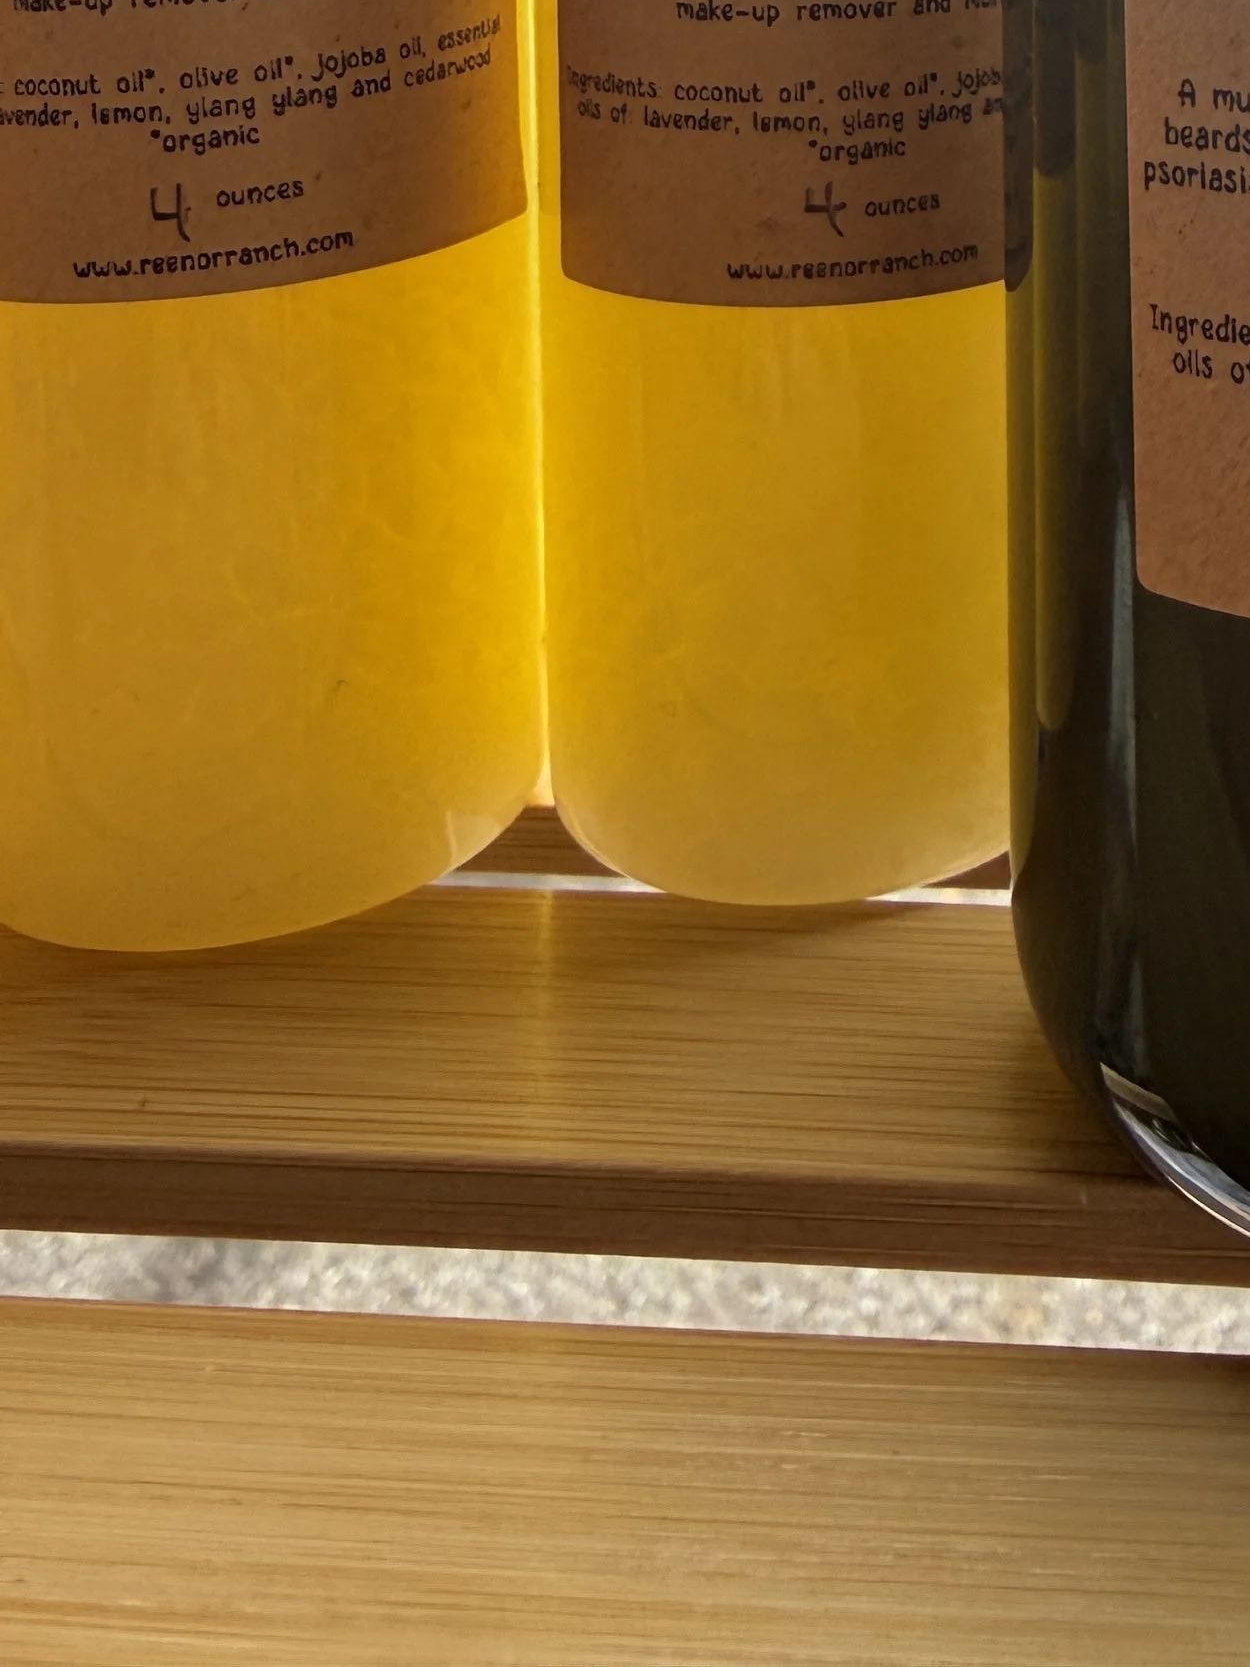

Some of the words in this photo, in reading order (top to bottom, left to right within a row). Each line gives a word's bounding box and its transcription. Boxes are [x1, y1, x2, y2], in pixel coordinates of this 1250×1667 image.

[796, 0, 898, 22] remover
[14, 73, 102, 97] coconut
[179, 66, 239, 90] olive
[311, 46, 387, 83] jojoba
[400, 35, 427, 60] oil,
[91, 102, 172, 126] lemon,
[186, 96, 257, 126] ylang
[272, 84, 338, 117] ylang
[351, 69, 392, 99] and
[674, 83, 764, 104] coconut
[837, 79, 891, 102] olive
[1177, 77, 1197, 109] A
[643, 104, 740, 136] lavender,
[752, 110, 829, 136] lemon,
[842, 108, 905, 136] ylang
[917, 101, 973, 131] ylang
[215, 178, 305, 208] ounces
[803, 180, 848, 239] 4
[864, 190, 942, 219] ounces
[150, 181, 192, 243] 4
[73, 229, 355, 279] www.reenorranch.com
[726, 242, 980, 283] www.reenorranch.com
[1171, 349, 1214, 380] oils
